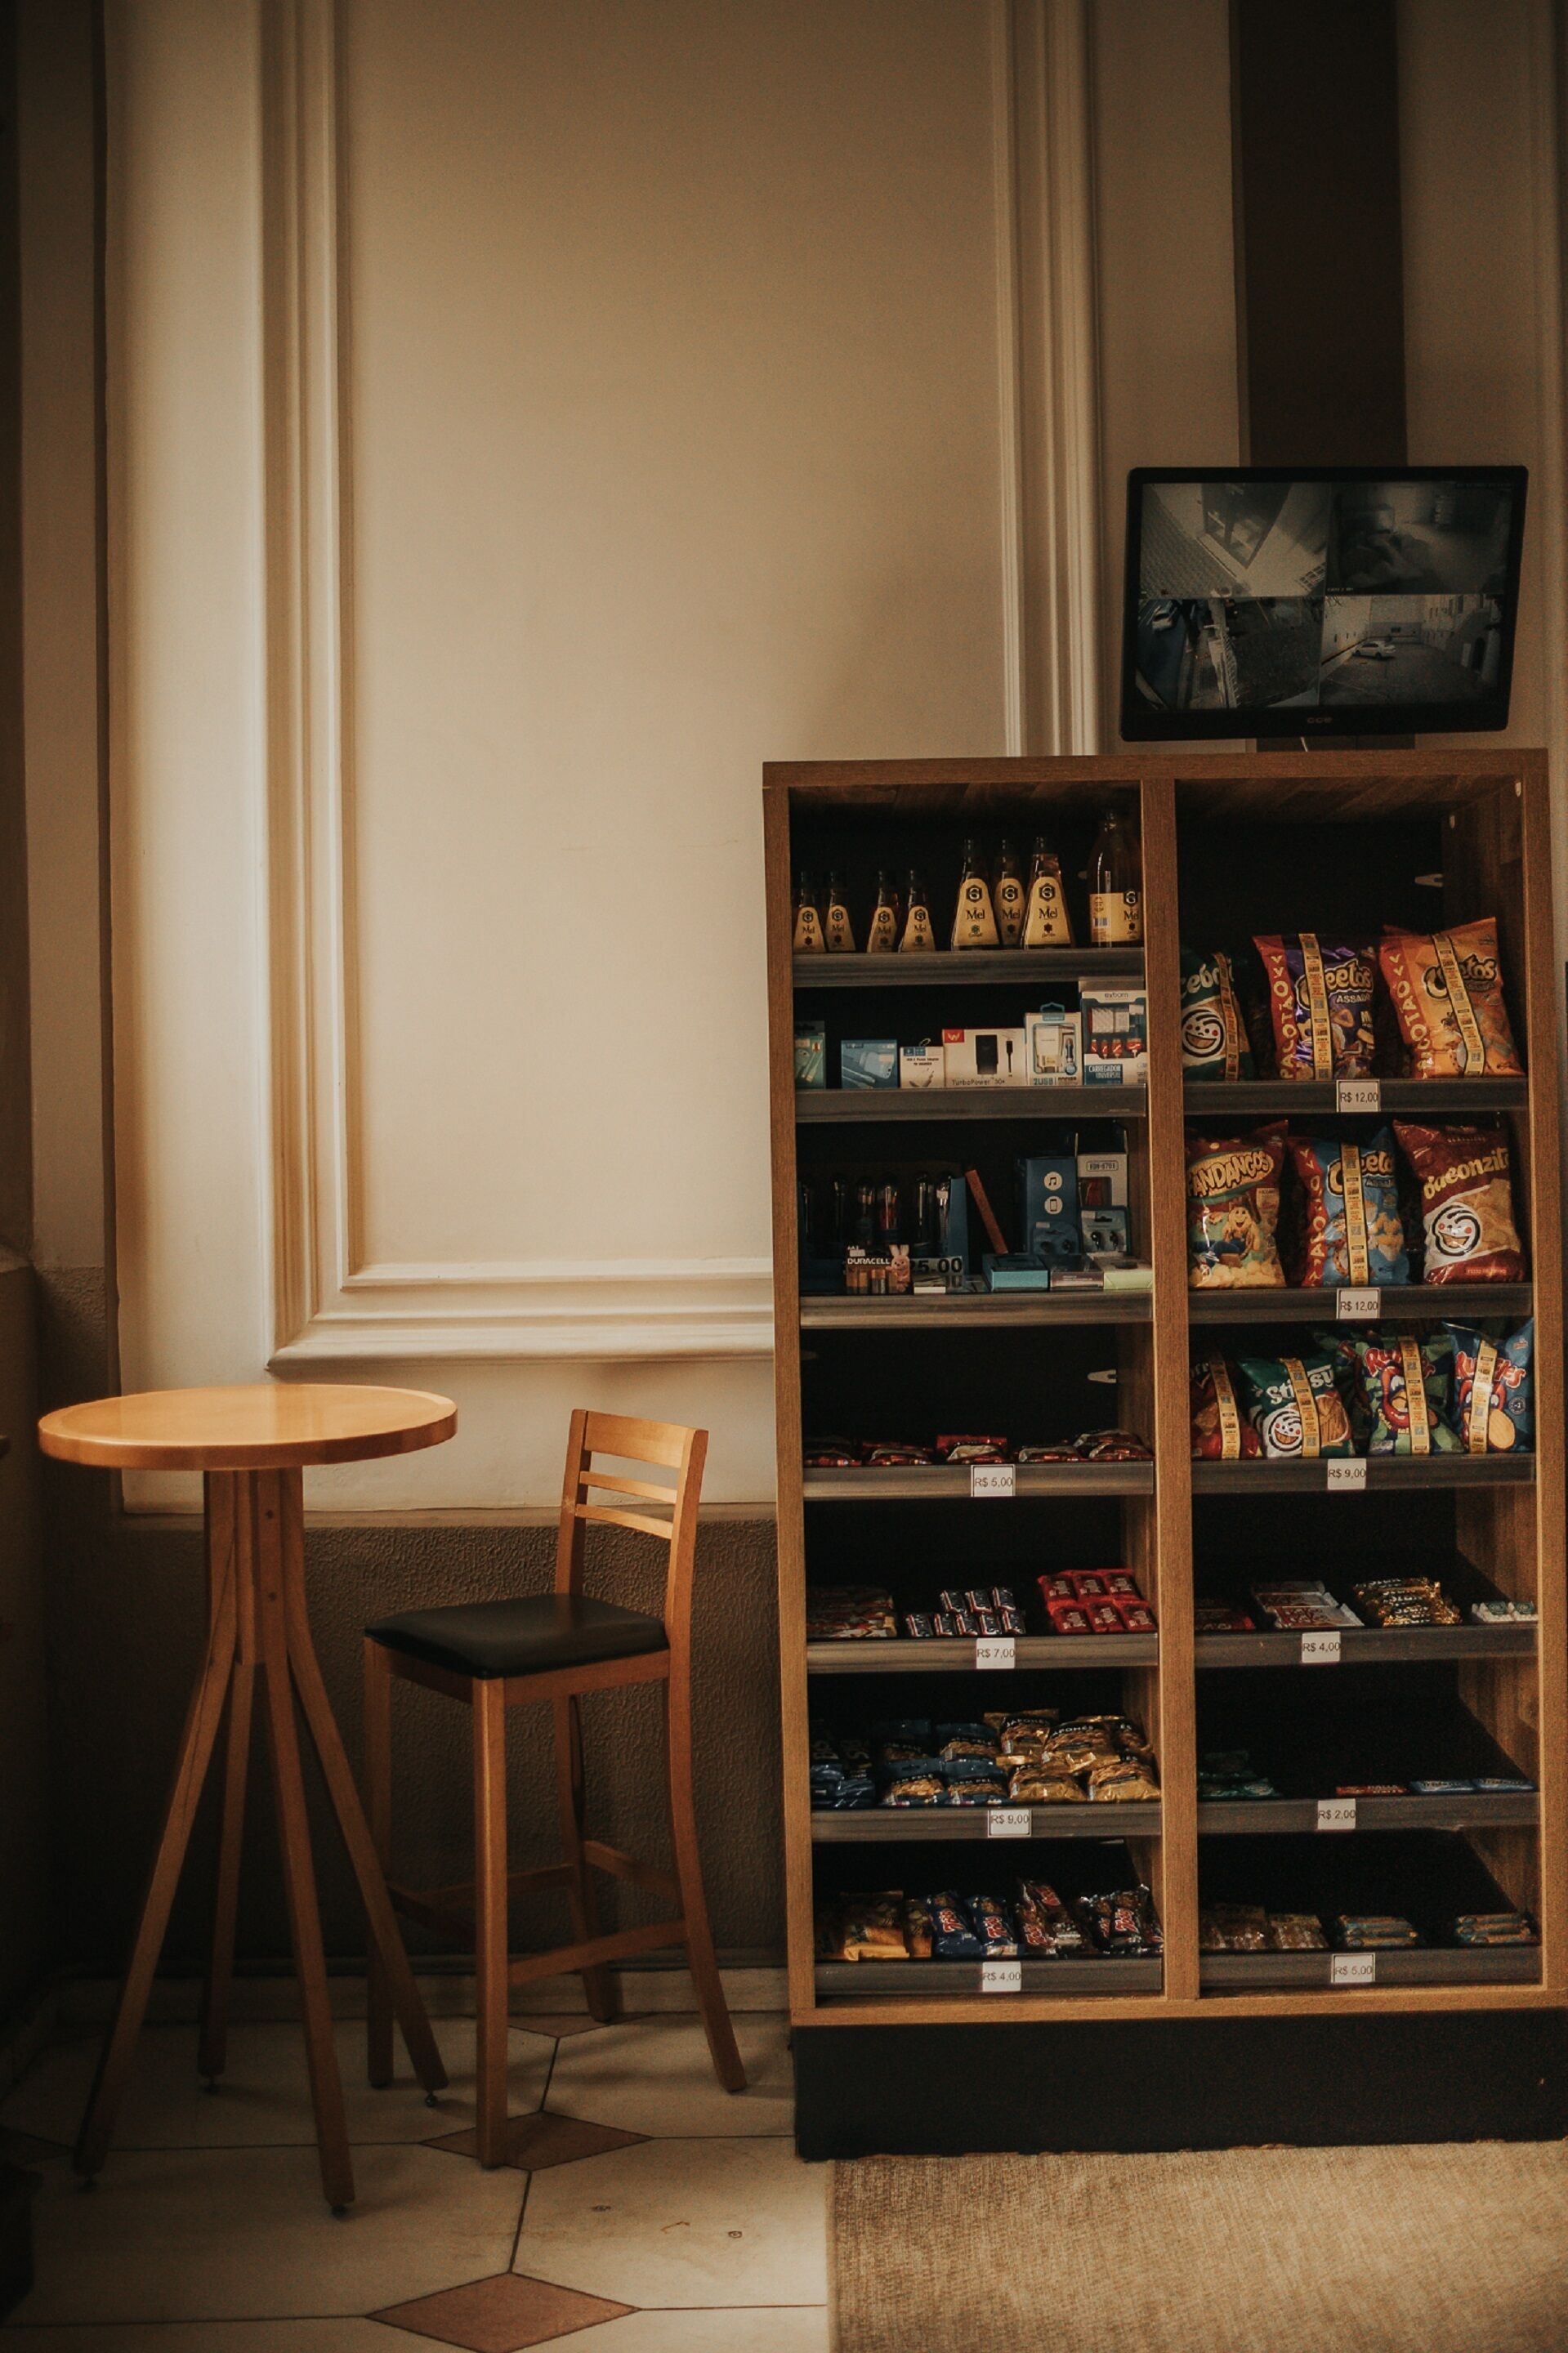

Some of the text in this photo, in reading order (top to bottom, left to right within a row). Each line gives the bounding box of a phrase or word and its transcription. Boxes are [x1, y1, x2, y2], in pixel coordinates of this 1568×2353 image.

[967, 909, 985, 920] Mel
[1002, 909, 1021, 920] Mel
[1039, 907, 1058, 919] Mel
[1297, 958, 1374, 1011] Ceetos
[1340, 1092, 1378, 1104] R$ 12,00
[1340, 1302, 1378, 1312] R$ 12,00
[1329, 1468, 1366, 1479] R$ 9,00
[975, 1477, 1012, 1488] R$ 5,00
[1302, 1642, 1340, 1653] R$ 4,00
[977, 1649, 1015, 1659] R$ 7,00
[1051, 1725, 1094, 1738] APONÊS
[991, 1815, 1030, 1825] R$ 9,00
[1318, 1810, 1356, 1820] R$ 2,00
[983, 1971, 1021, 1981] R$ 4,00
[1335, 1966, 1348, 1976] R$
